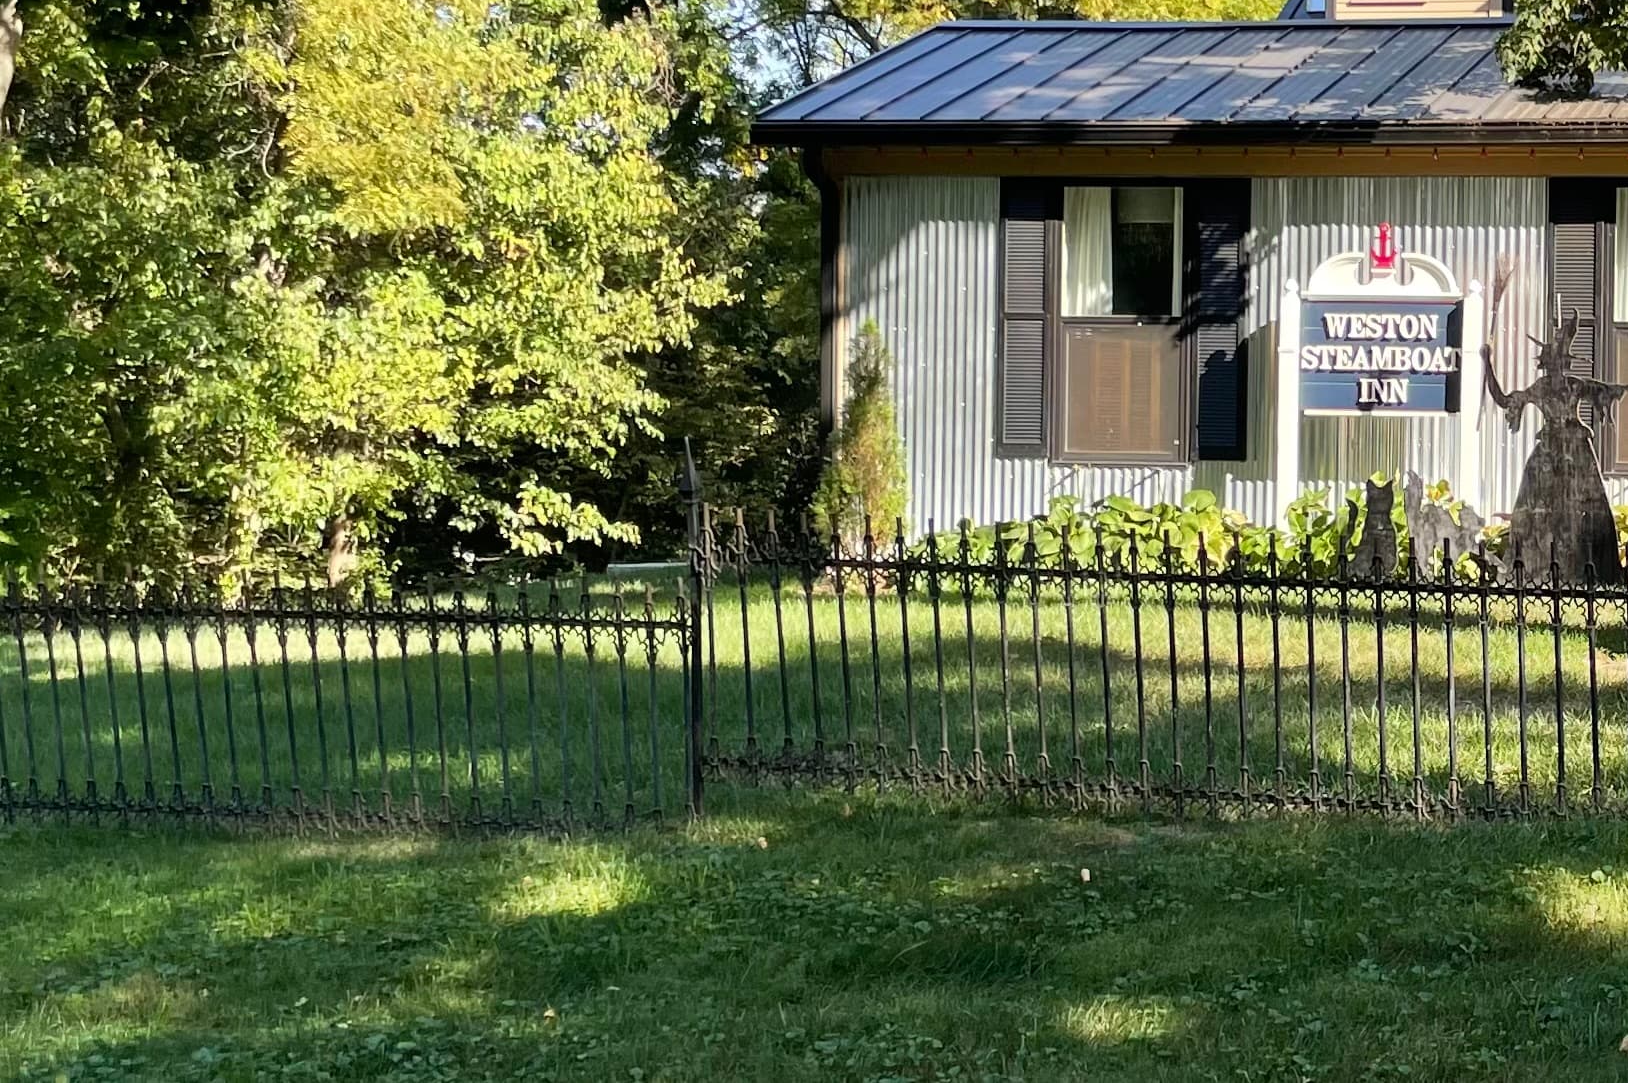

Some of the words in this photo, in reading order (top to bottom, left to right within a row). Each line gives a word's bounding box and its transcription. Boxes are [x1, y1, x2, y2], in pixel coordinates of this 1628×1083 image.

[1323, 313, 1439, 339] WESTON
[1301, 345, 1463, 372] STEAMBOAT
[1358, 377, 1410, 404] INN
